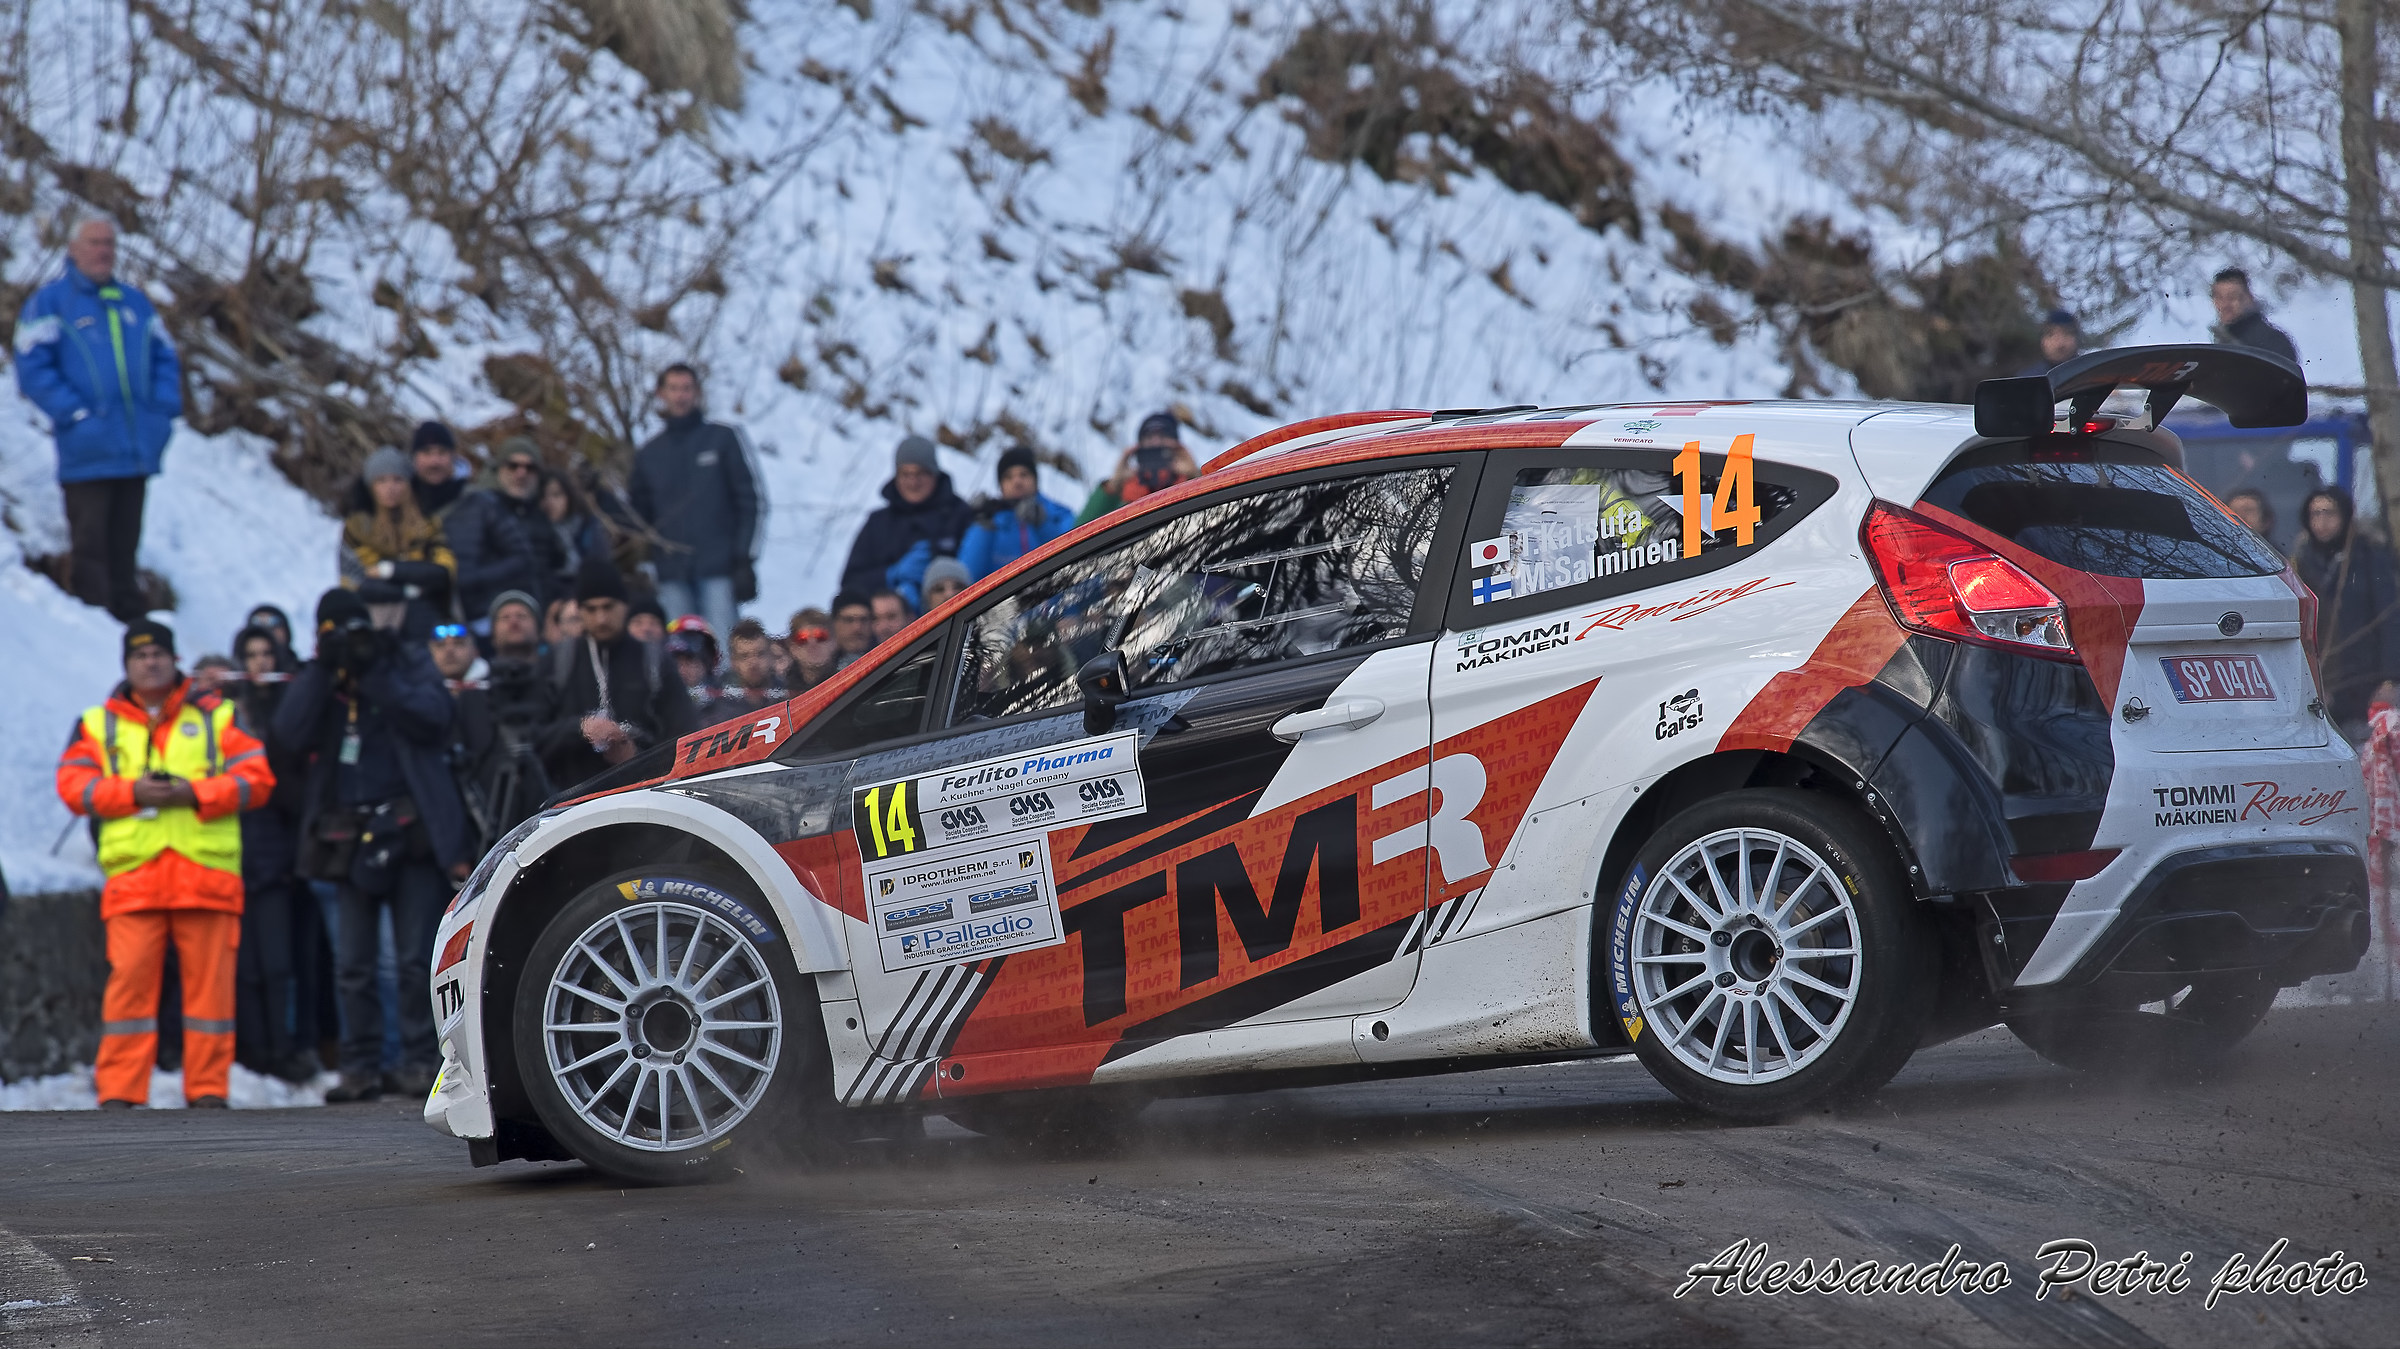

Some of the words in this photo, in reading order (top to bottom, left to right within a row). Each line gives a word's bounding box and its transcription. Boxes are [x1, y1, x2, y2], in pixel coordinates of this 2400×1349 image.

[1673, 433, 1761, 560] 14
[1518, 507, 1643, 558] T.Katsuta
[1519, 537, 1678, 593] M.Salminen
[1458, 621, 1571, 658] TOMMI
[1575, 576, 1797, 641] Racing
[1456, 635, 1569, 673] MÄKINEN
[2181, 660, 2212, 698] SP
[2214, 660, 2269, 697] 0474
[684, 716, 781, 764] TMR
[1655, 707, 1704, 741] Cars!
[940, 765, 1018, 793] Ferlito
[1022, 747, 1113, 775] Pharma
[950, 788, 985, 801] Kuehne
[998, 780, 1024, 792] Nagel
[1026, 772, 1070, 785] Company
[865, 781, 915, 857] 14
[1029, 811, 1056, 820] Cooperativa
[1099, 797, 1125, 806] Cooperativa
[2153, 785, 2235, 808] TOMMI
[2240, 781, 2359, 826] Racing
[2155, 808, 2237, 827] MÄKINEN
[963, 824, 989, 834] Cooperativa
[903, 861, 989, 886] IDROTHERM
[921, 869, 997, 889] www.idrotherm.net
[1060, 753, 1493, 1029] TMR
[661, 881, 768, 937] MICHELIN
[886, 902, 947, 921] GPS
[970, 884, 1031, 903] GPS
[904, 949, 935, 960] INDUSTRIE
[937, 942, 969, 954] GRAFICHE
[970, 932, 1025, 948] CARTOTECNICHE
[924, 915, 1033, 949] Palladio
[940, 942, 1001, 958] www.palladio.it
[1616, 873, 1643, 995] MICHELIN
